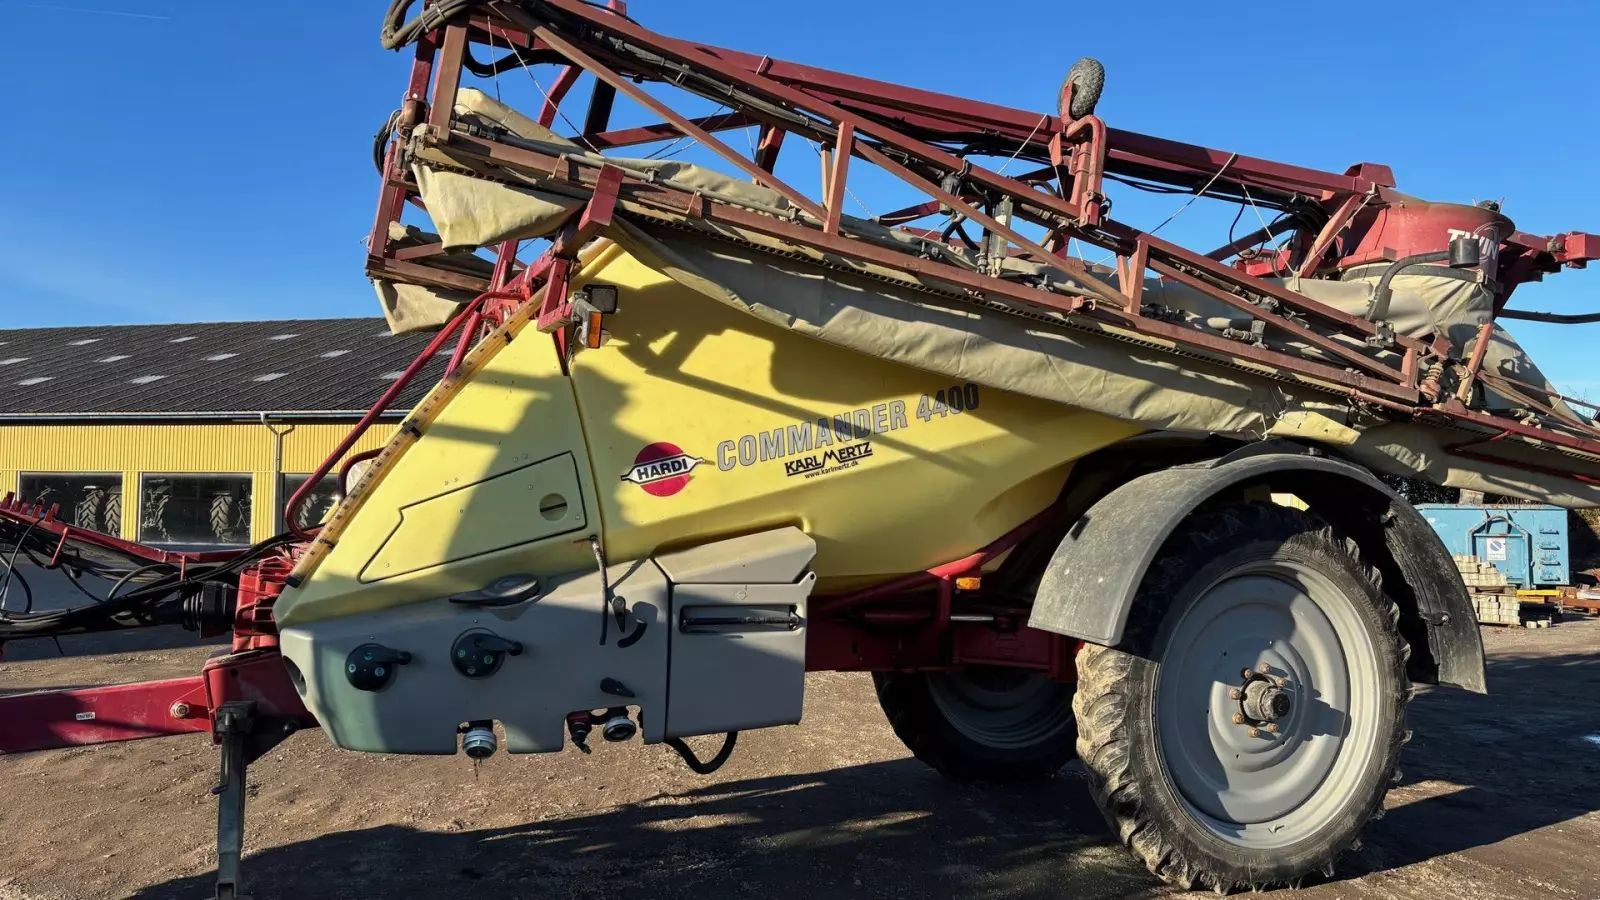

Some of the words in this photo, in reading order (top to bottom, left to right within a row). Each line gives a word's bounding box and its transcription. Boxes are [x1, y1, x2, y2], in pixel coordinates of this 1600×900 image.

[717, 400, 908, 472] COMMANDER
[916, 383, 980, 422] 4400
[636, 458, 689, 480] HARDI
[784, 455, 822, 474] KARL
[804, 460, 859, 479] www.karlmertz.dk
